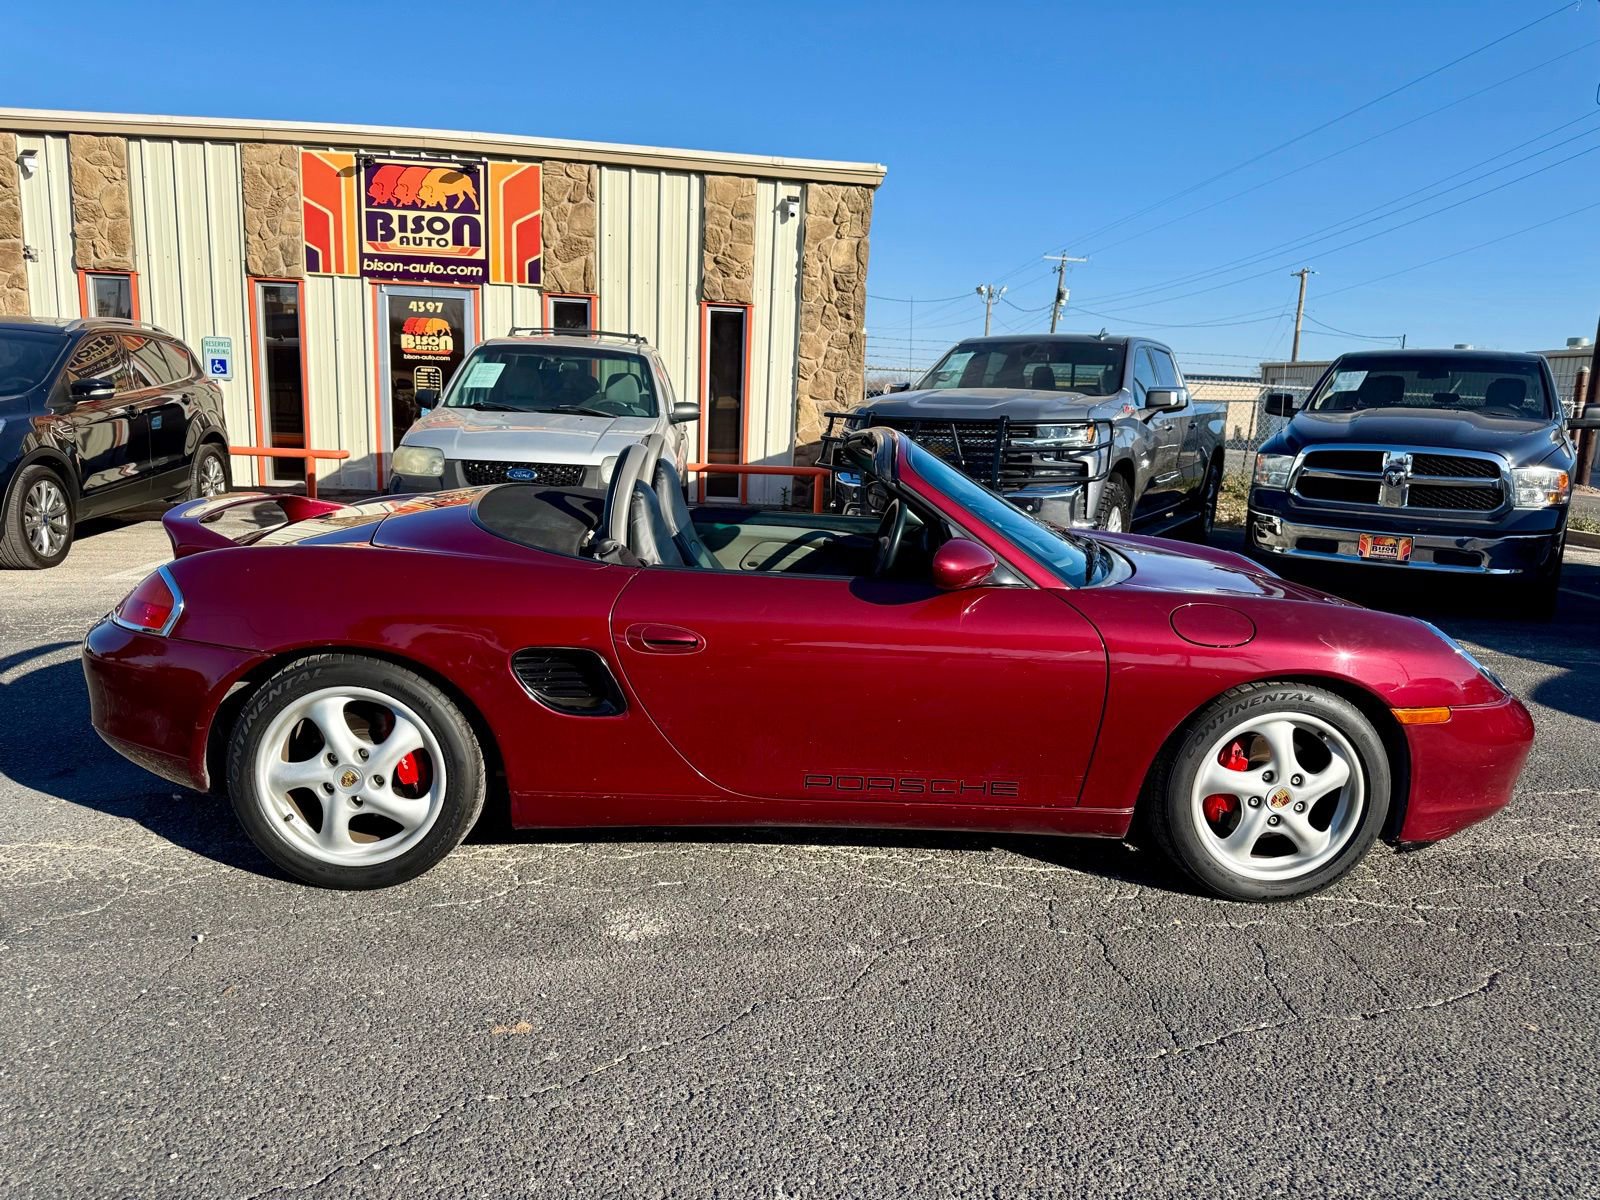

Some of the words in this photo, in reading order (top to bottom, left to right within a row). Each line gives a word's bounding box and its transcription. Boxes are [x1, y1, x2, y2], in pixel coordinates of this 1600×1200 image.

[365, 210, 482, 248] BISON
[399, 236, 449, 248] AUTO
[363, 258, 483, 277] bison-auto.com
[409, 301, 443, 313] 4397
[400, 334, 454, 351] BISON
[403, 353, 451, 361] bison-auto.com
[1187, 692, 1317, 759] CONTINENTAL
[804, 774, 1020, 797] PORSCHE
